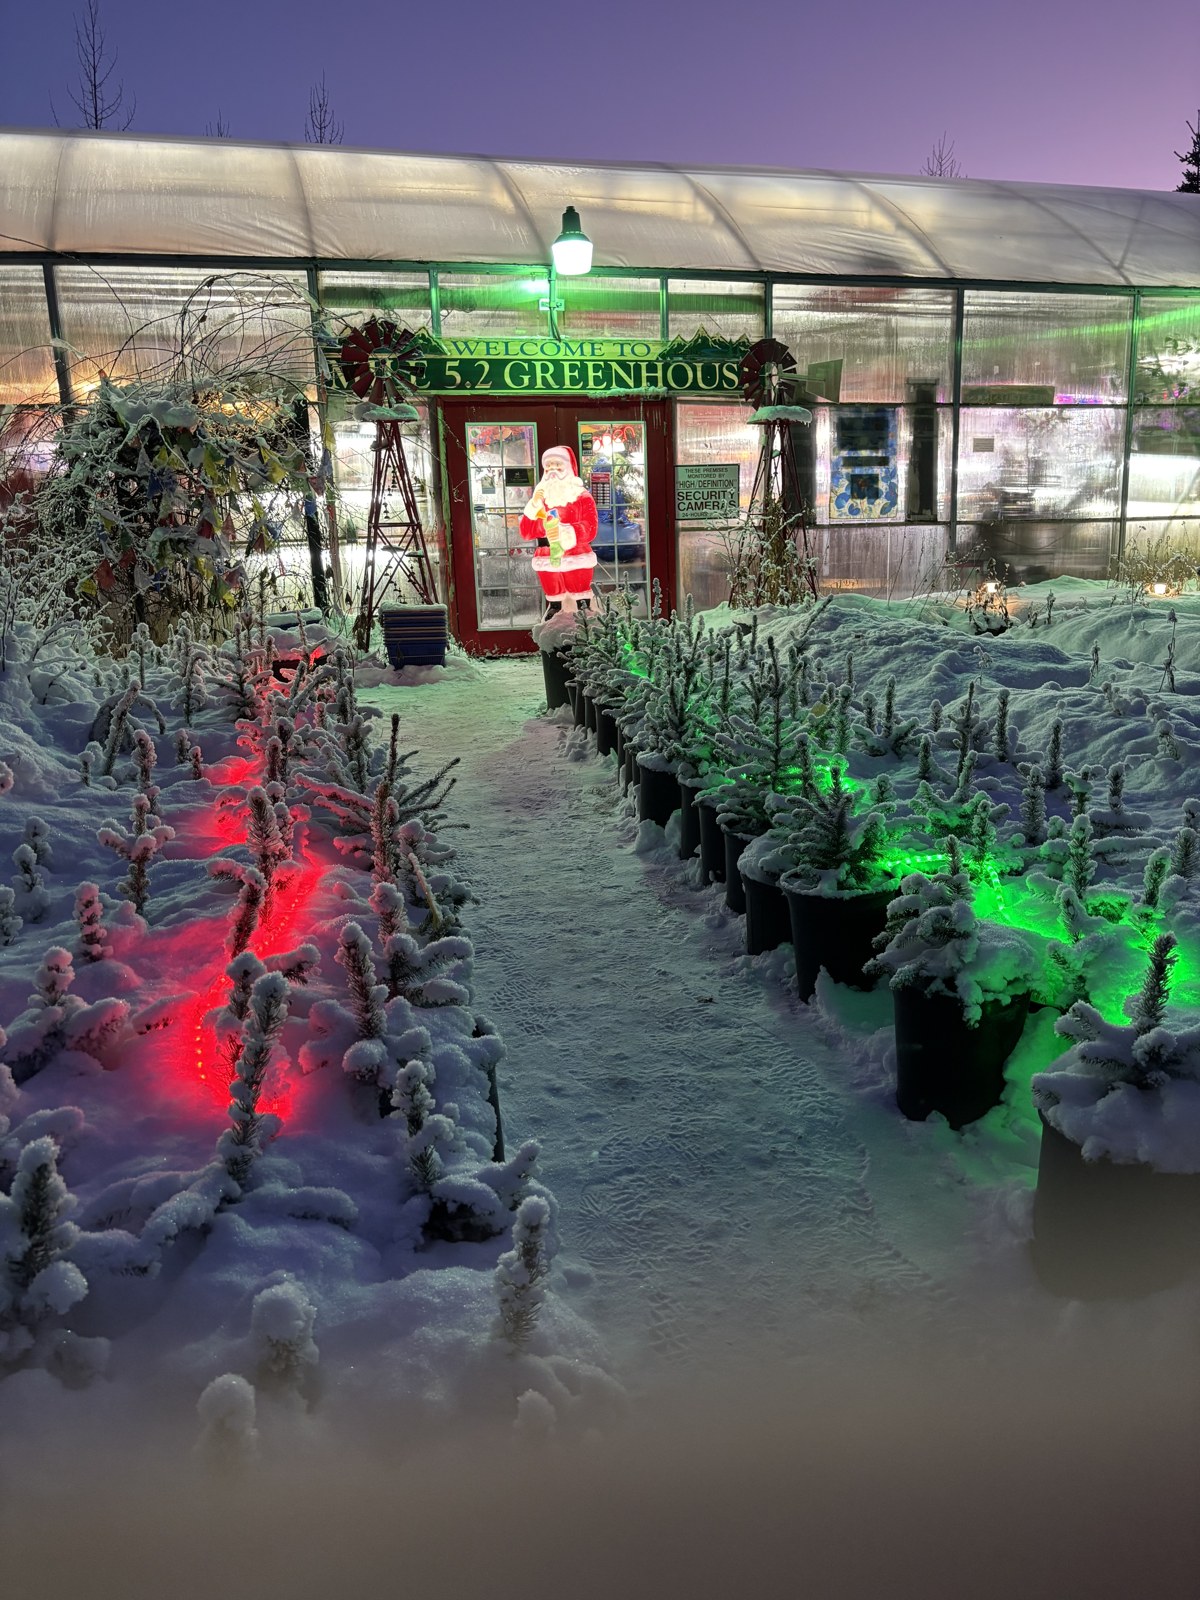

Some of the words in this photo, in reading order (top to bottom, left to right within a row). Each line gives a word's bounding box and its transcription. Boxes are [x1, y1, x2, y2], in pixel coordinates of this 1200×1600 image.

[450, 340, 605, 357] WELCOME
[613, 342, 651, 357] TO
[444, 359, 493, 389] 5.2
[503, 360, 749, 390] GREENHOUS
[677, 491, 735, 501] SECURITY
